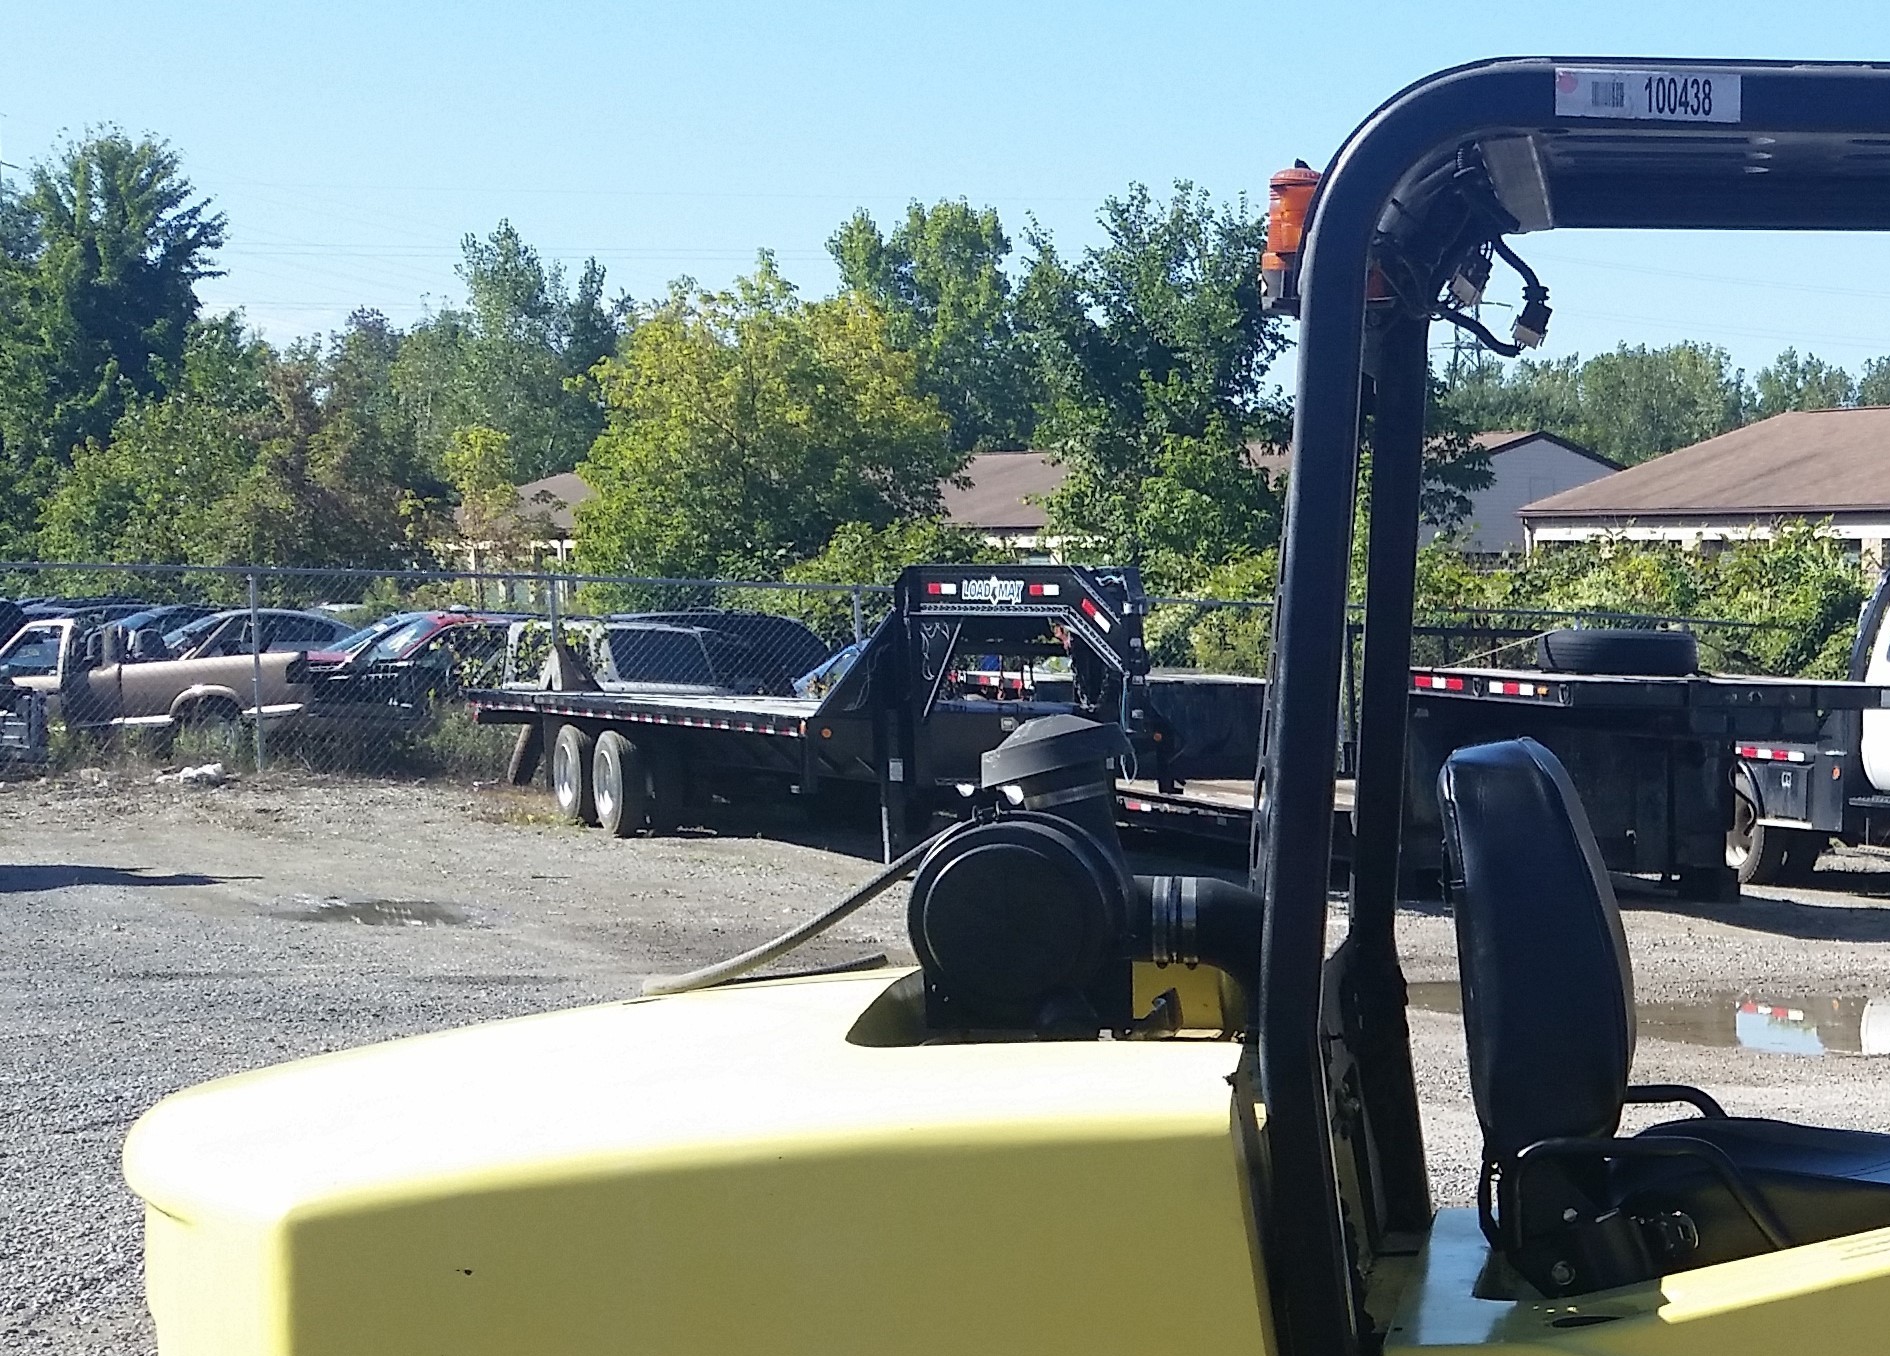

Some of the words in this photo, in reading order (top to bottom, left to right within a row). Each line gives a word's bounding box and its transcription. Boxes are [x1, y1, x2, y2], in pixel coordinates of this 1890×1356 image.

[1644, 76, 1713, 116] 100438
[962, 580, 991, 600] LOAD
[998, 580, 1024, 603] MAX
